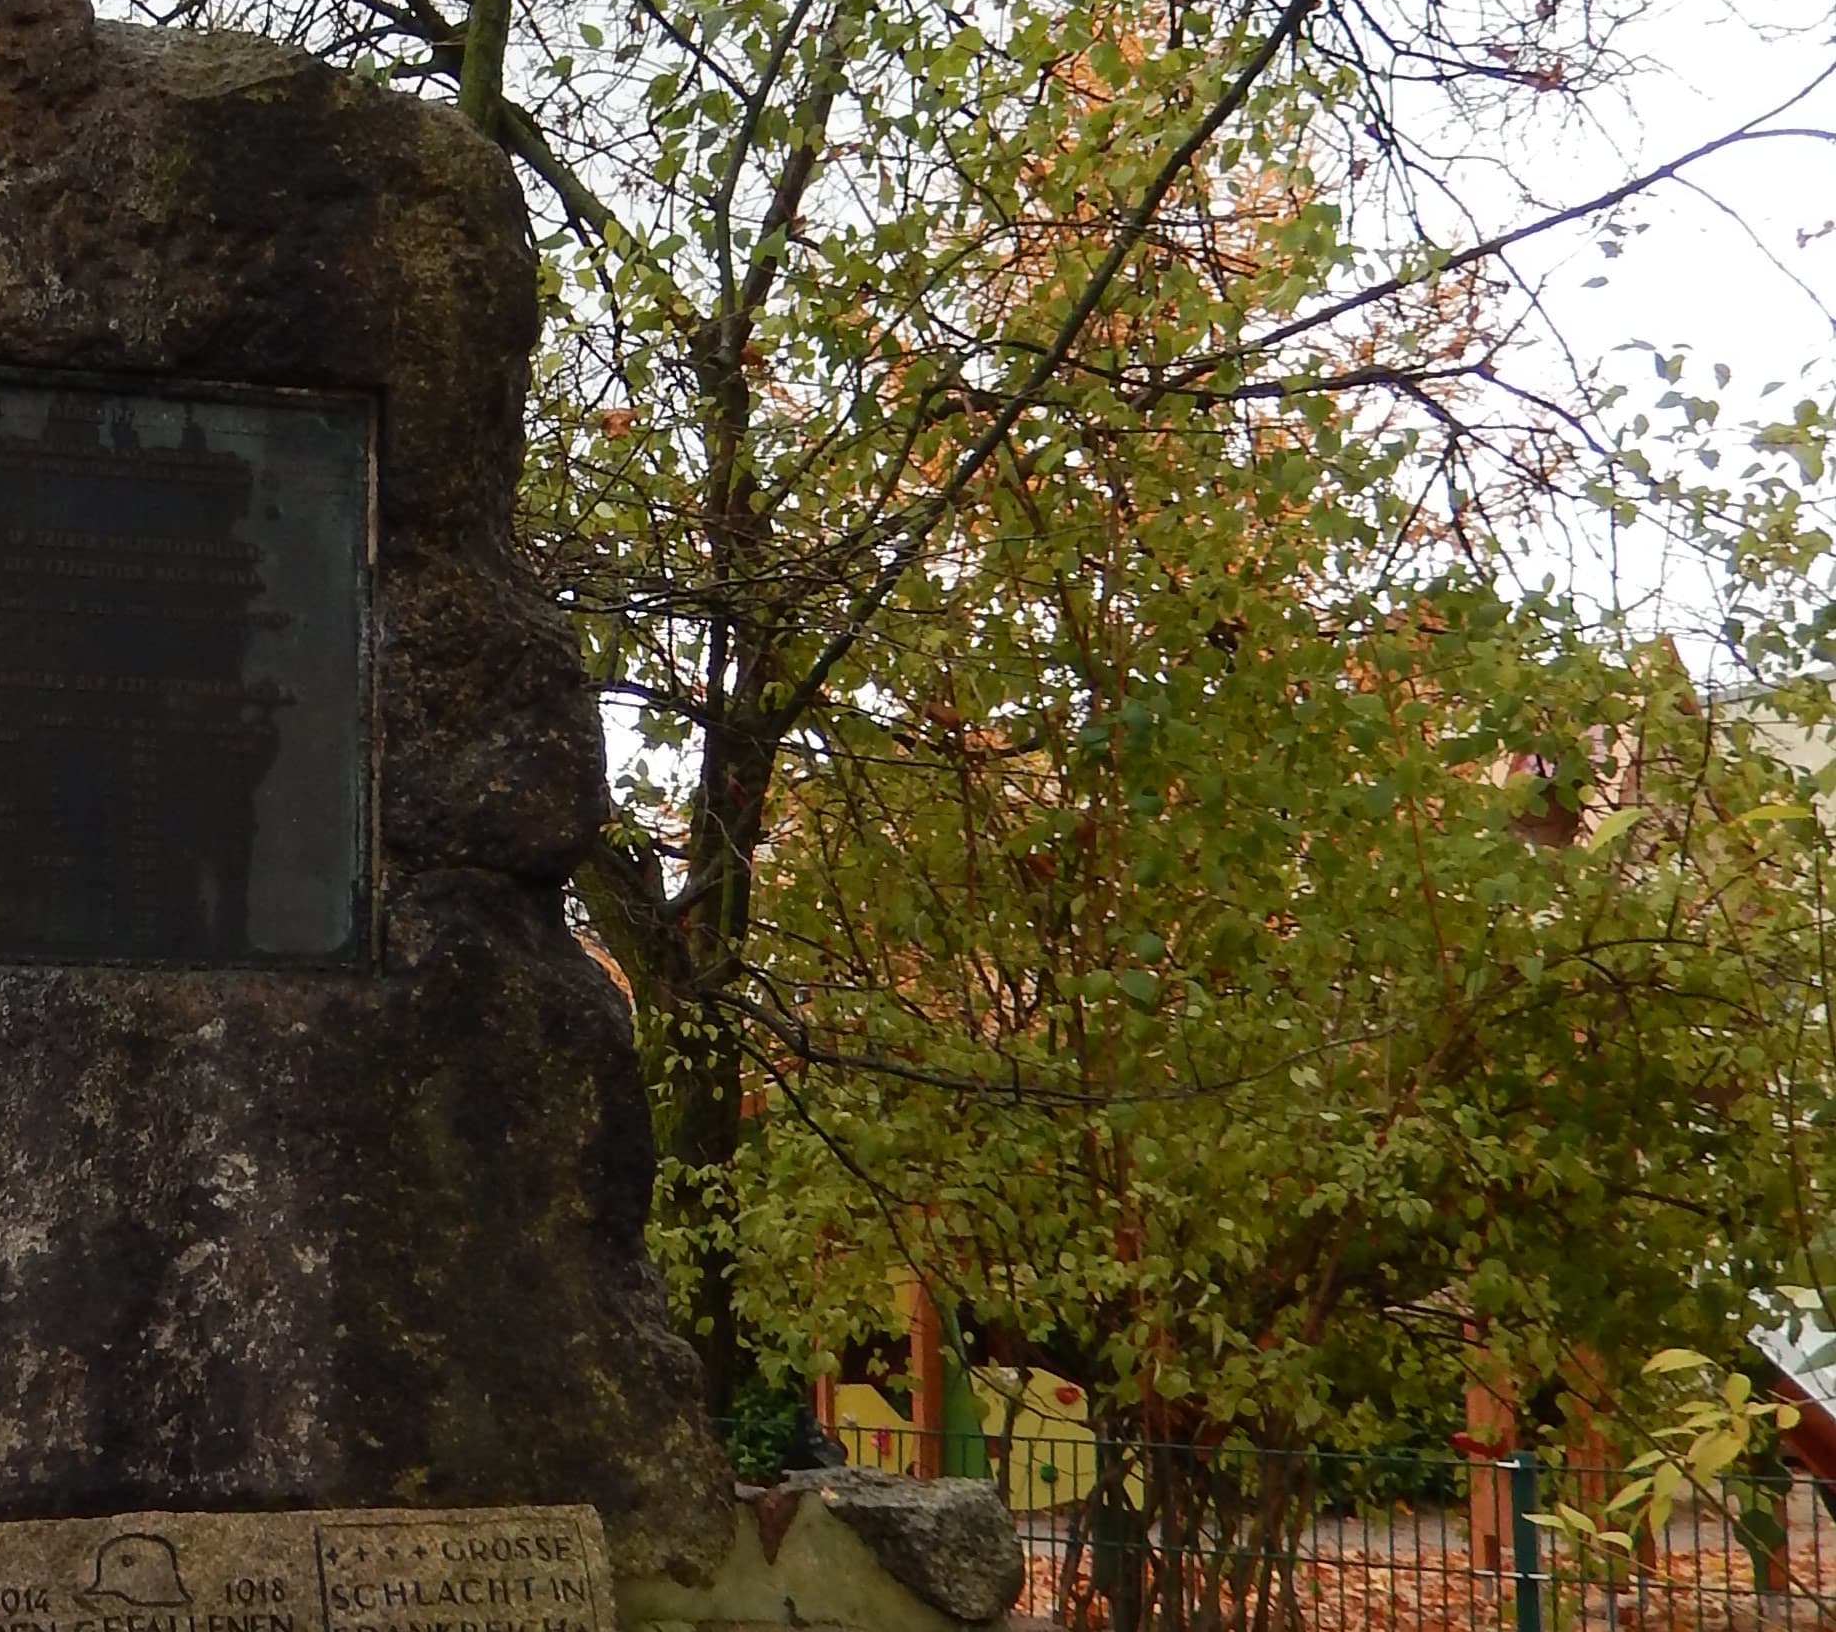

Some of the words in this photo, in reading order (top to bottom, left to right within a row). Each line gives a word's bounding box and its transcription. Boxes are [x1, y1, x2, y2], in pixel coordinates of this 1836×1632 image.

[441, 1536, 575, 1563] GROSSE
[330, 1576, 536, 1611] SCHLACHT
[550, 1576, 586, 1603] IN
